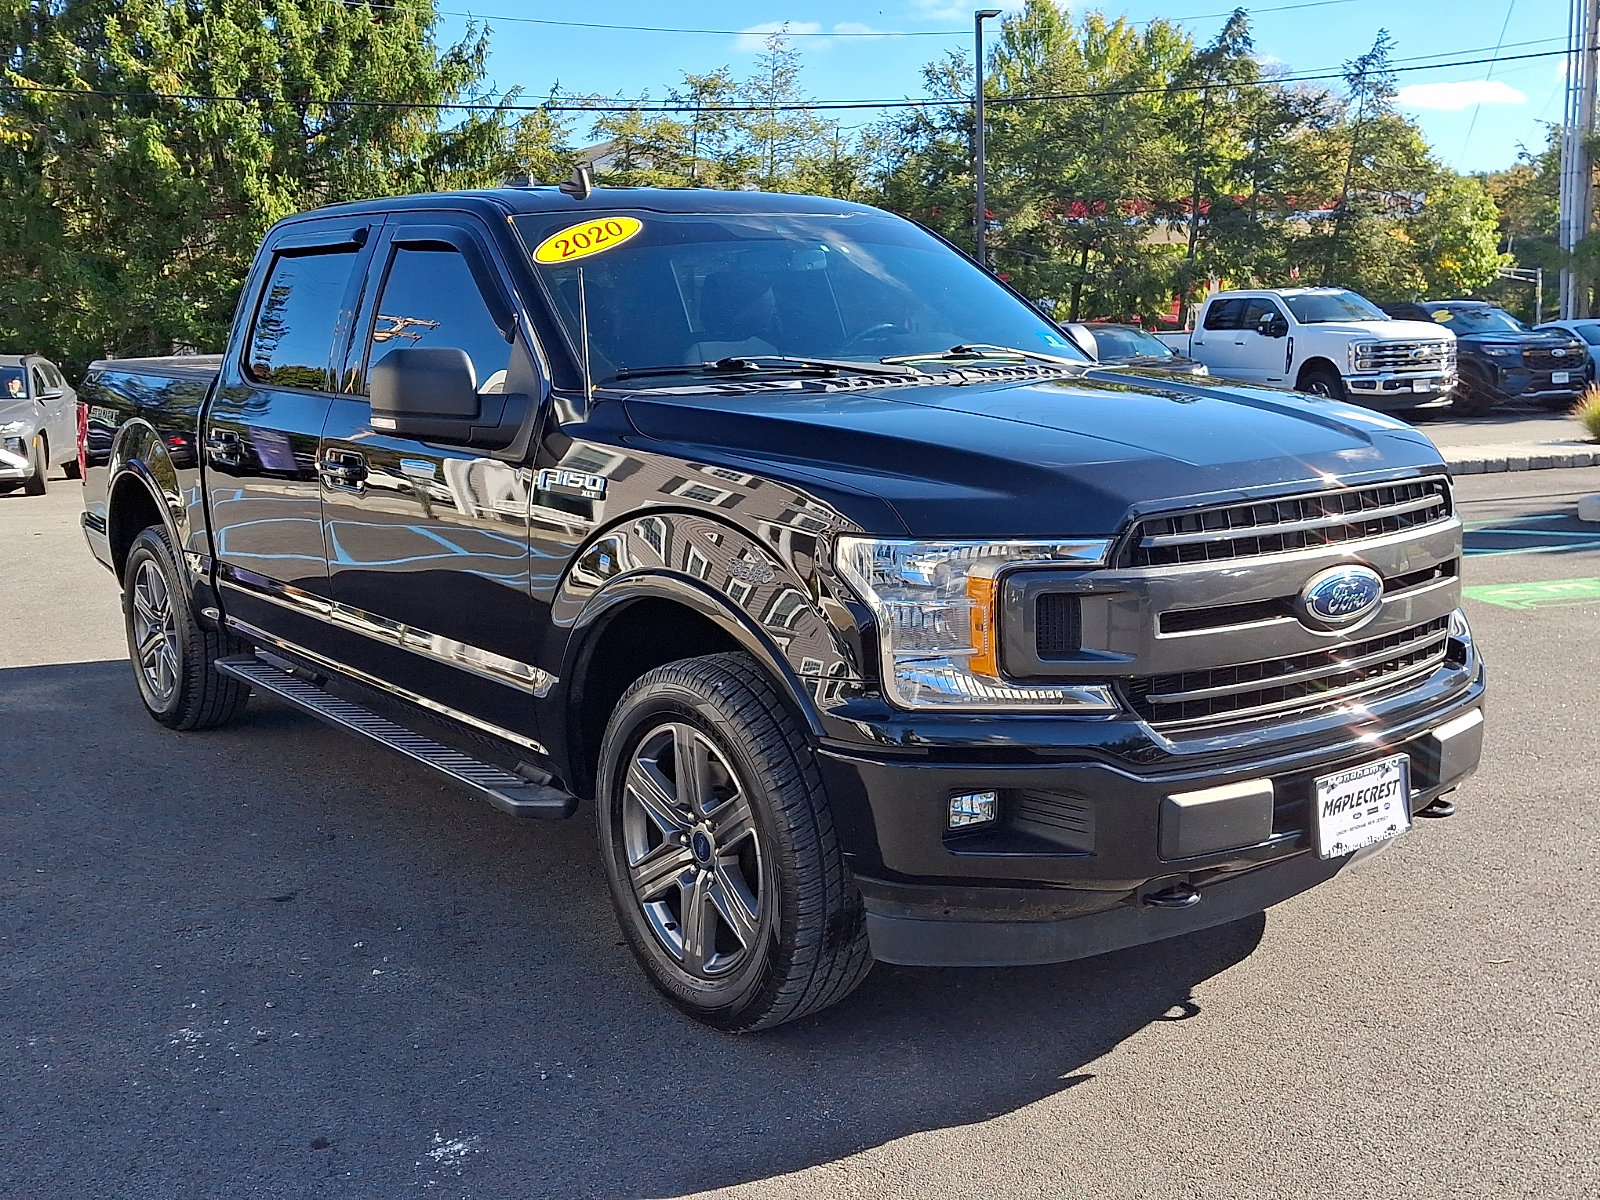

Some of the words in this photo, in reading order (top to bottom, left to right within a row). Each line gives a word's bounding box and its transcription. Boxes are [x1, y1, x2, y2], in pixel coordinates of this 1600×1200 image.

[554, 220, 623, 258] 2020
[89, 405, 120, 422] SPORT
[581, 489, 597, 498] XLT
[1327, 580, 1369, 614] Ford
[1322, 778, 1401, 819] MAPLECREST
